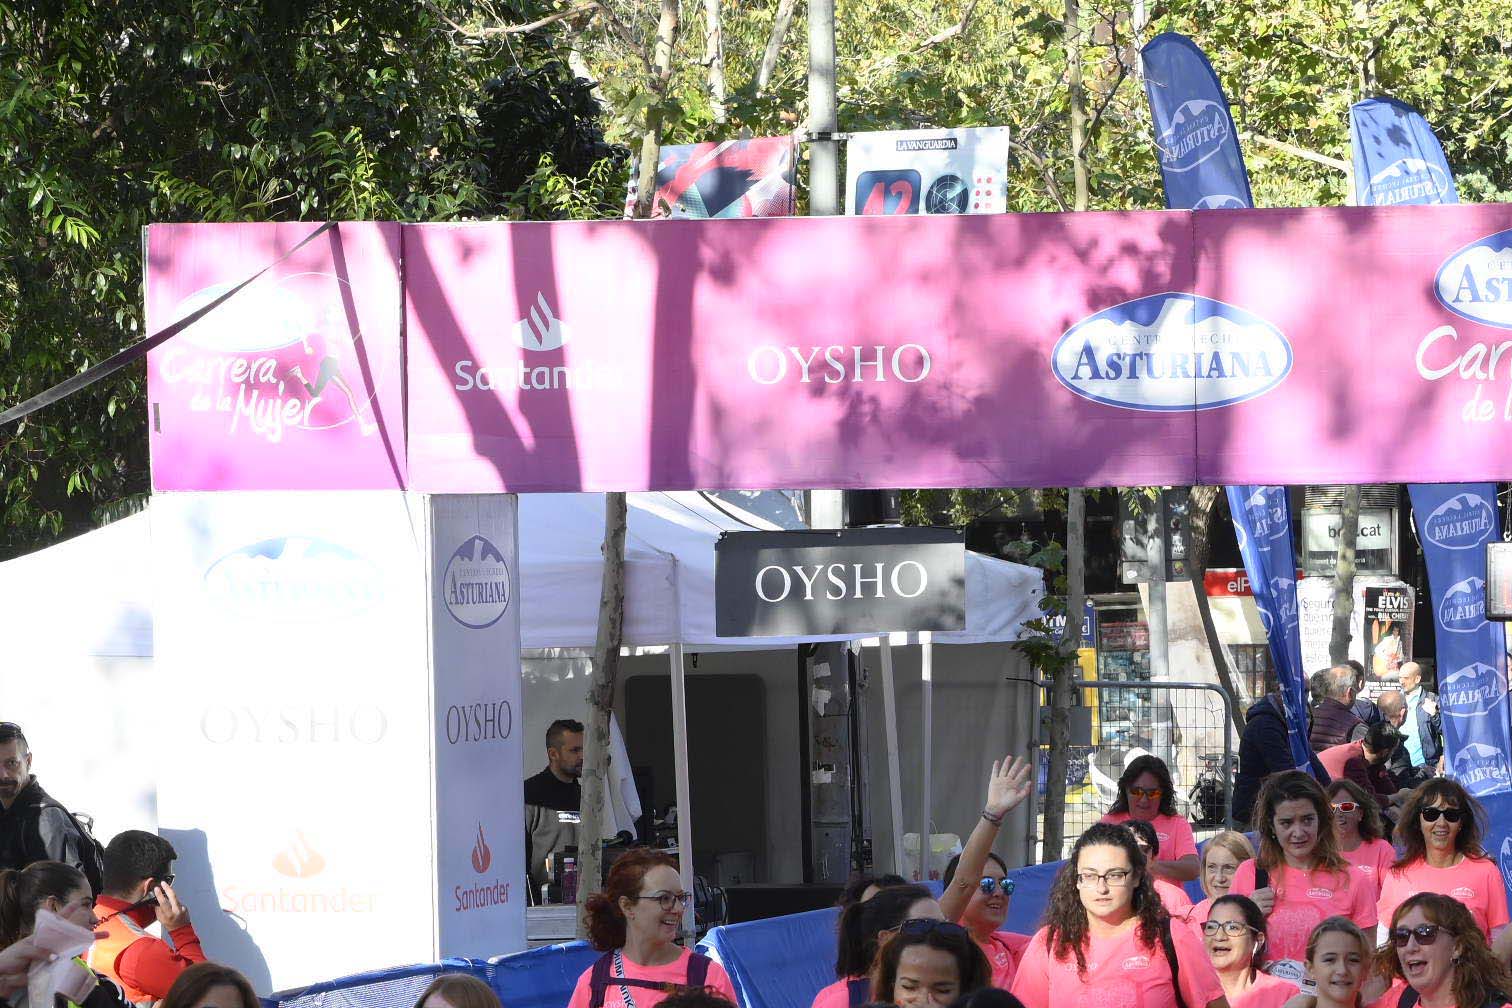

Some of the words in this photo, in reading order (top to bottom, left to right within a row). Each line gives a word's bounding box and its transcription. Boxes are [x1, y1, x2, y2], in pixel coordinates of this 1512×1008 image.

[747, 343, 932, 386] OYSHO
[1070, 334, 1274, 382] ASTURIANA
[1462, 384, 1496, 423] de
[448, 569, 507, 606] ASTURIANA
[755, 560, 929, 603] OYSHO
[1377, 612, 1391, 620] BILL
[1378, 596, 1409, 609] ELVIS
[200, 702, 389, 746] OYSHO
[445, 700, 513, 746] OYSHO
[220, 885, 377, 915] Santander
[454, 880, 510, 913] Santander
